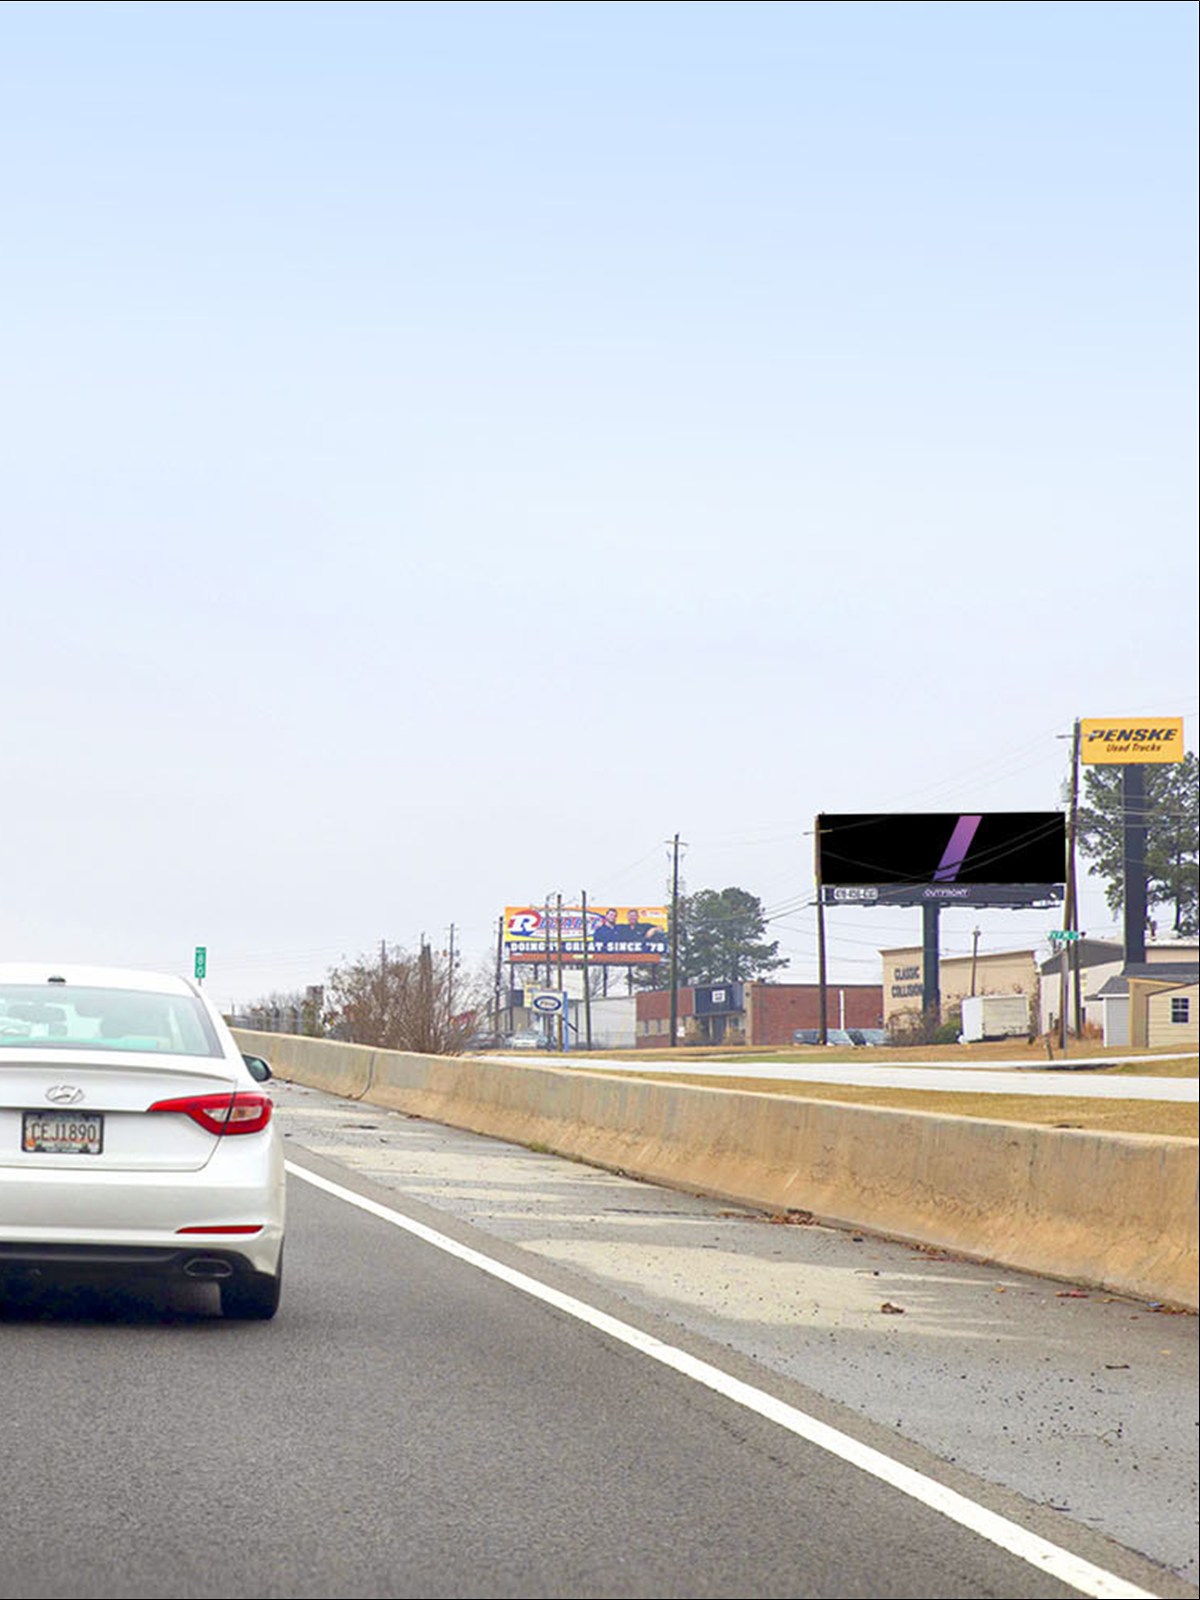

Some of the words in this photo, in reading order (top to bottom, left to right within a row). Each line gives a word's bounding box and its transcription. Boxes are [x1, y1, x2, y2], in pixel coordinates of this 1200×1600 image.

[1088, 728, 1178, 742] PENSKE
[1106, 744, 1129, 752] Used
[1132, 743, 1161, 752] Trucks
[923, 888, 969, 897] OUTFRONT
[510, 942, 547, 952] DOING
[607, 942, 642, 952] SINCE
[894, 966, 920, 981] CLASSIC
[891, 983, 925, 999] COLLISION
[31, 1122, 97, 1143] CEJ1890
